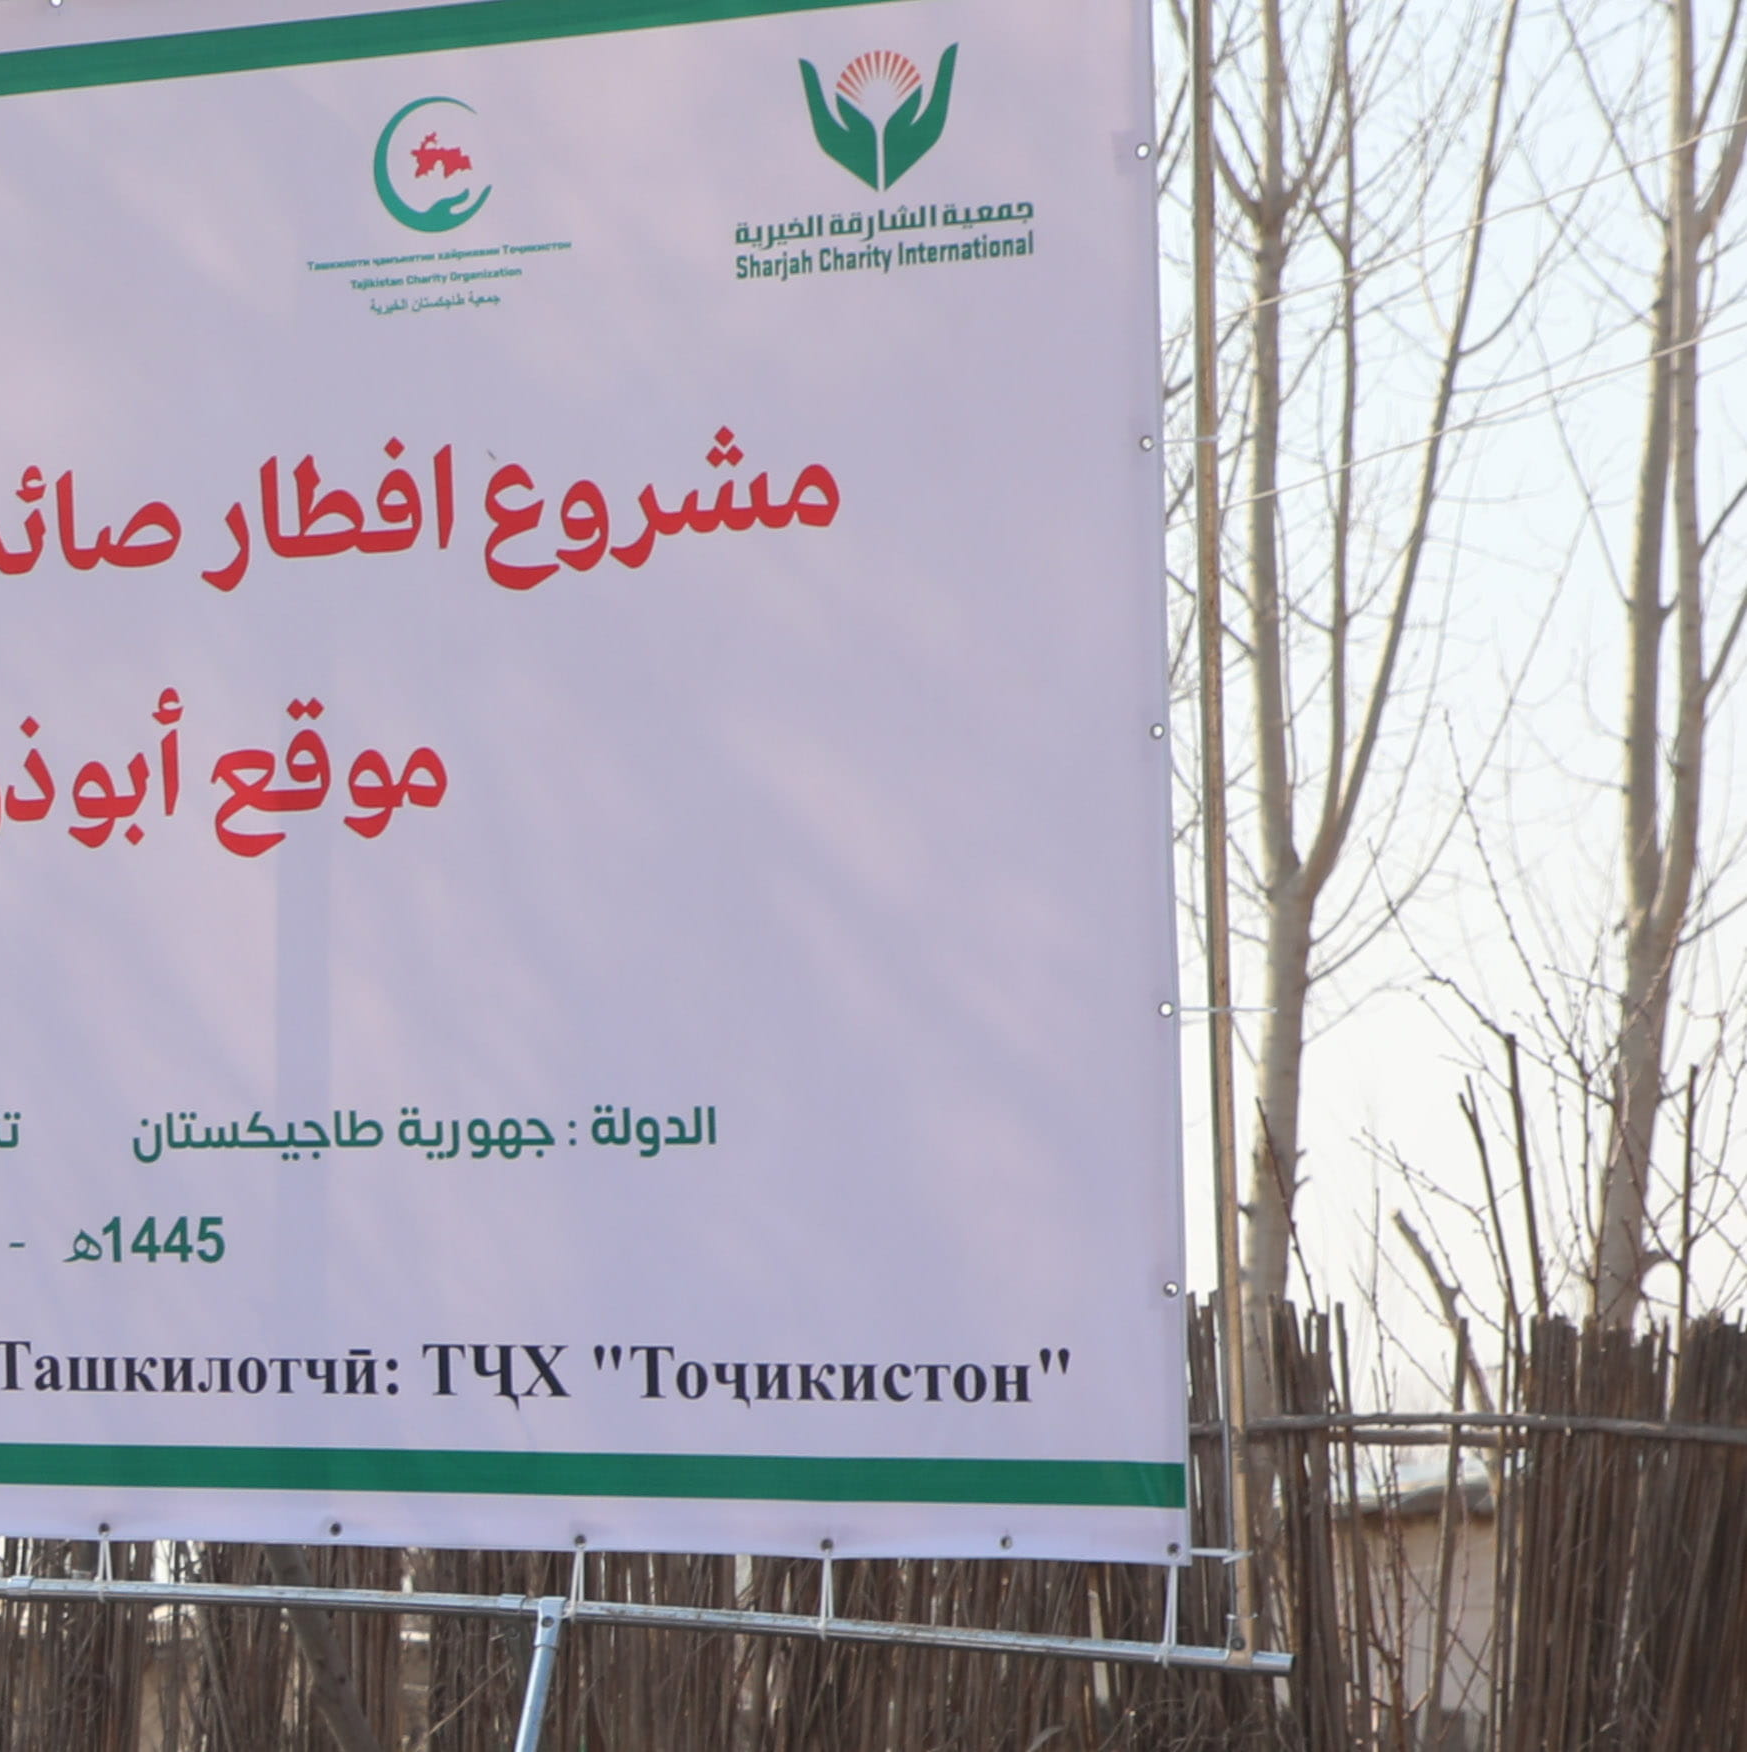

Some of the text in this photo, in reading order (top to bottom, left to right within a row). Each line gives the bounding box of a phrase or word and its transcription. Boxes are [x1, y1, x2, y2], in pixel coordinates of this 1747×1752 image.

[736, 202, 1033, 249] جمعية الشارقة الخيرية
[351, 268, 522, 290] Tajikistan Charity Organization
[736, 230, 1033, 281] Sharjah Charity International
[201, 437, 454, 592] افطار
[485, 426, 840, 590] مشروع
[211, 698, 447, 857] موقع
[133, 1111, 383, 1163] طاجيكستان
[399, 1108, 555, 1160] جهورية
[592, 1105, 716, 1157] الدولة
[423, 1344, 569, 1408] ТҶХ
[594, 1345, 1069, 1406] "Тоҷикистон"
